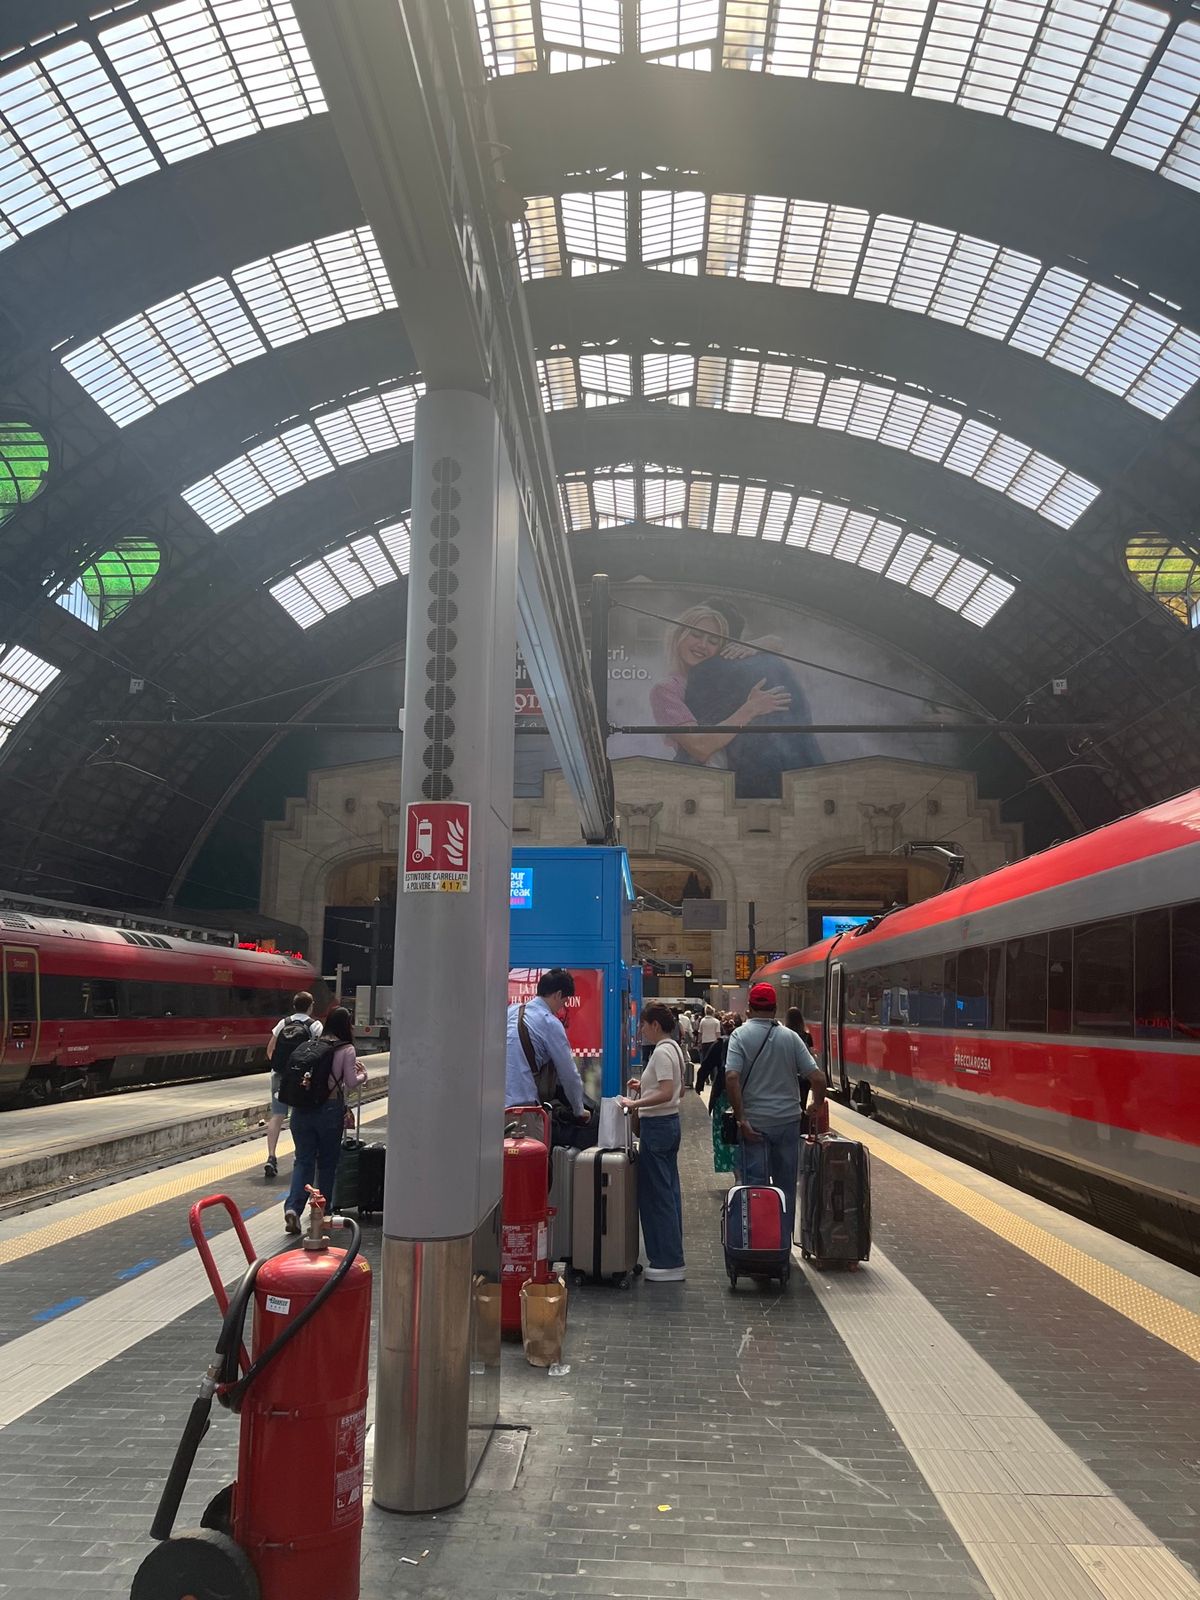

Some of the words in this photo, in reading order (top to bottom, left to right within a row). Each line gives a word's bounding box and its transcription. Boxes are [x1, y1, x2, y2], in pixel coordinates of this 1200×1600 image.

[607, 664, 652, 680] ccio.
[405, 872, 431, 882] ESTINTORE
[510, 872, 525, 880] our
[510, 880, 523, 888] est
[510, 888, 531, 897] reak
[953, 1053, 991, 1071] FRECCIAROSSA
